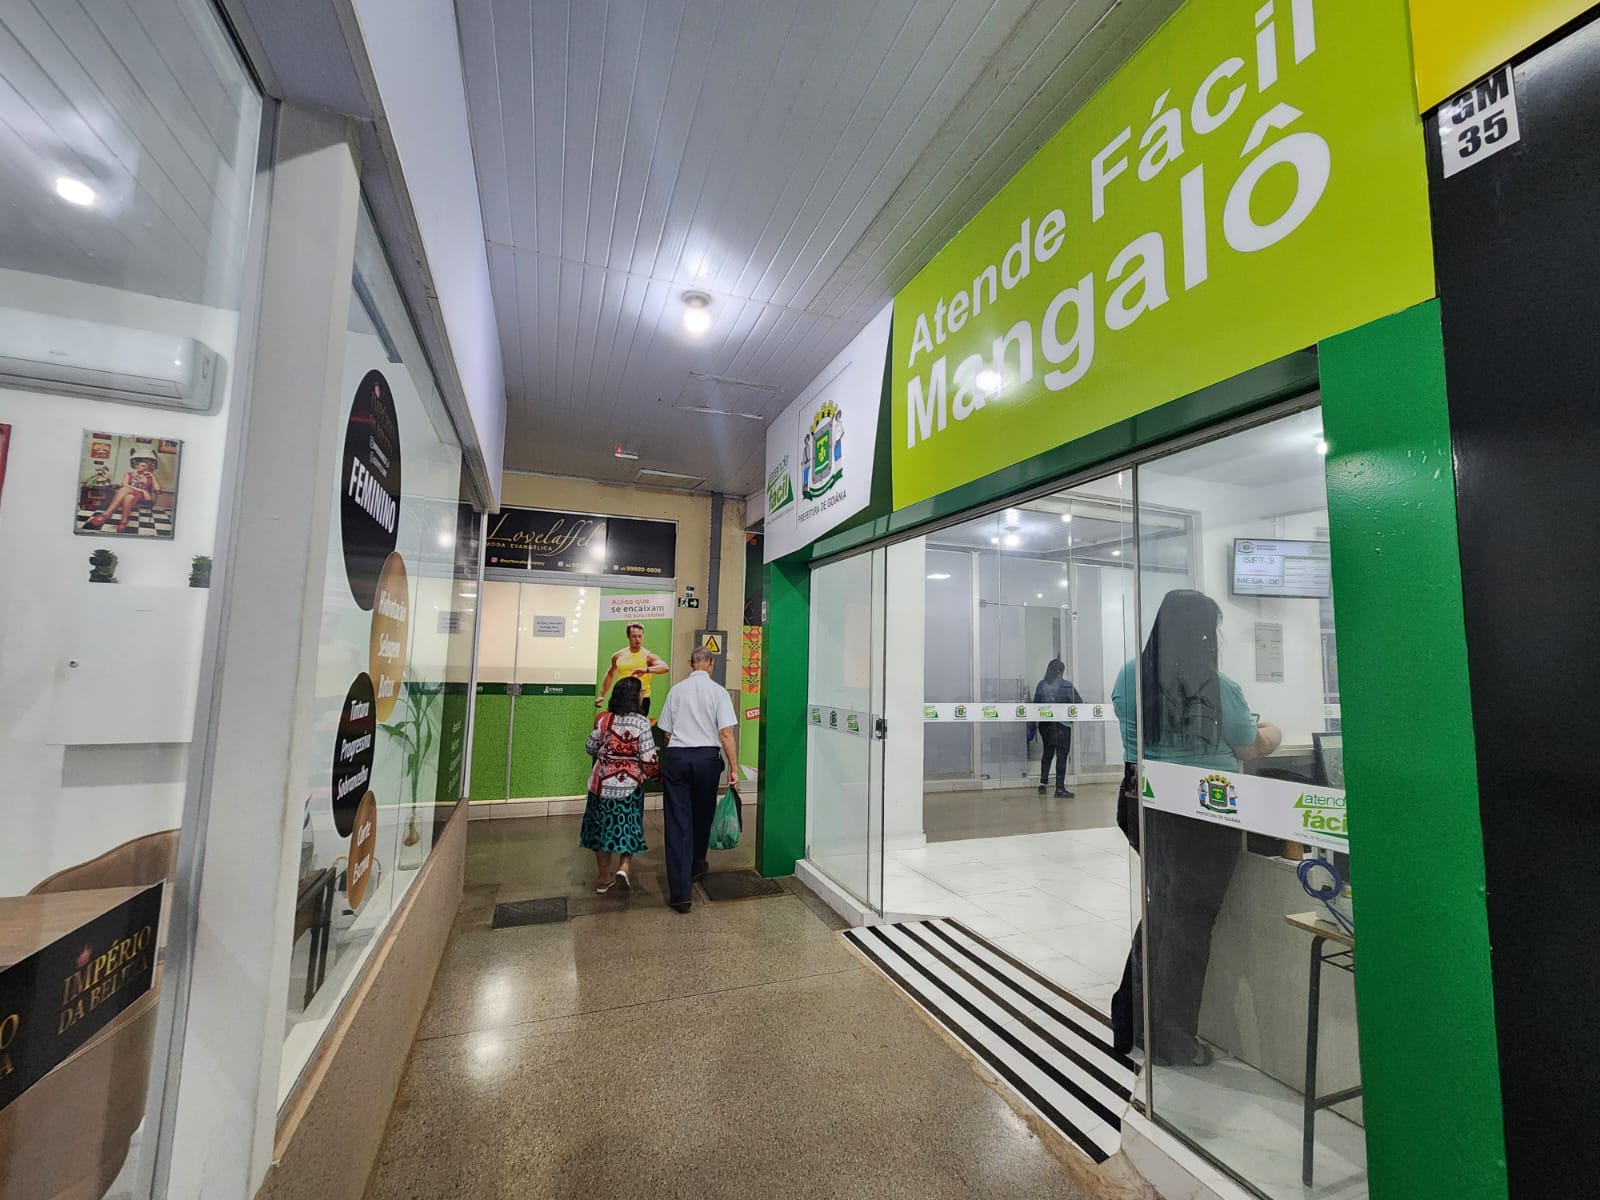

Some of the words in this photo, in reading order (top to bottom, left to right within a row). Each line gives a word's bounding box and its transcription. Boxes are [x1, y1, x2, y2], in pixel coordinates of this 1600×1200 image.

[1451, 67, 1509, 125] GM
[1458, 109, 1508, 158] 35
[907, 209, 1066, 368] Atende
[1091, 0, 1317, 223] Fácil
[906, 102, 1332, 449] Mangalô
[349, 456, 397, 535] FEMININO
[611, 605, 621, 613] se
[623, 605, 665, 613] encaixam
[1302, 809, 1348, 833] fáci
[1304, 794, 1347, 807] atend
[63, 925, 151, 1005] IMPÉRIO
[57, 1000, 85, 1036] DA
